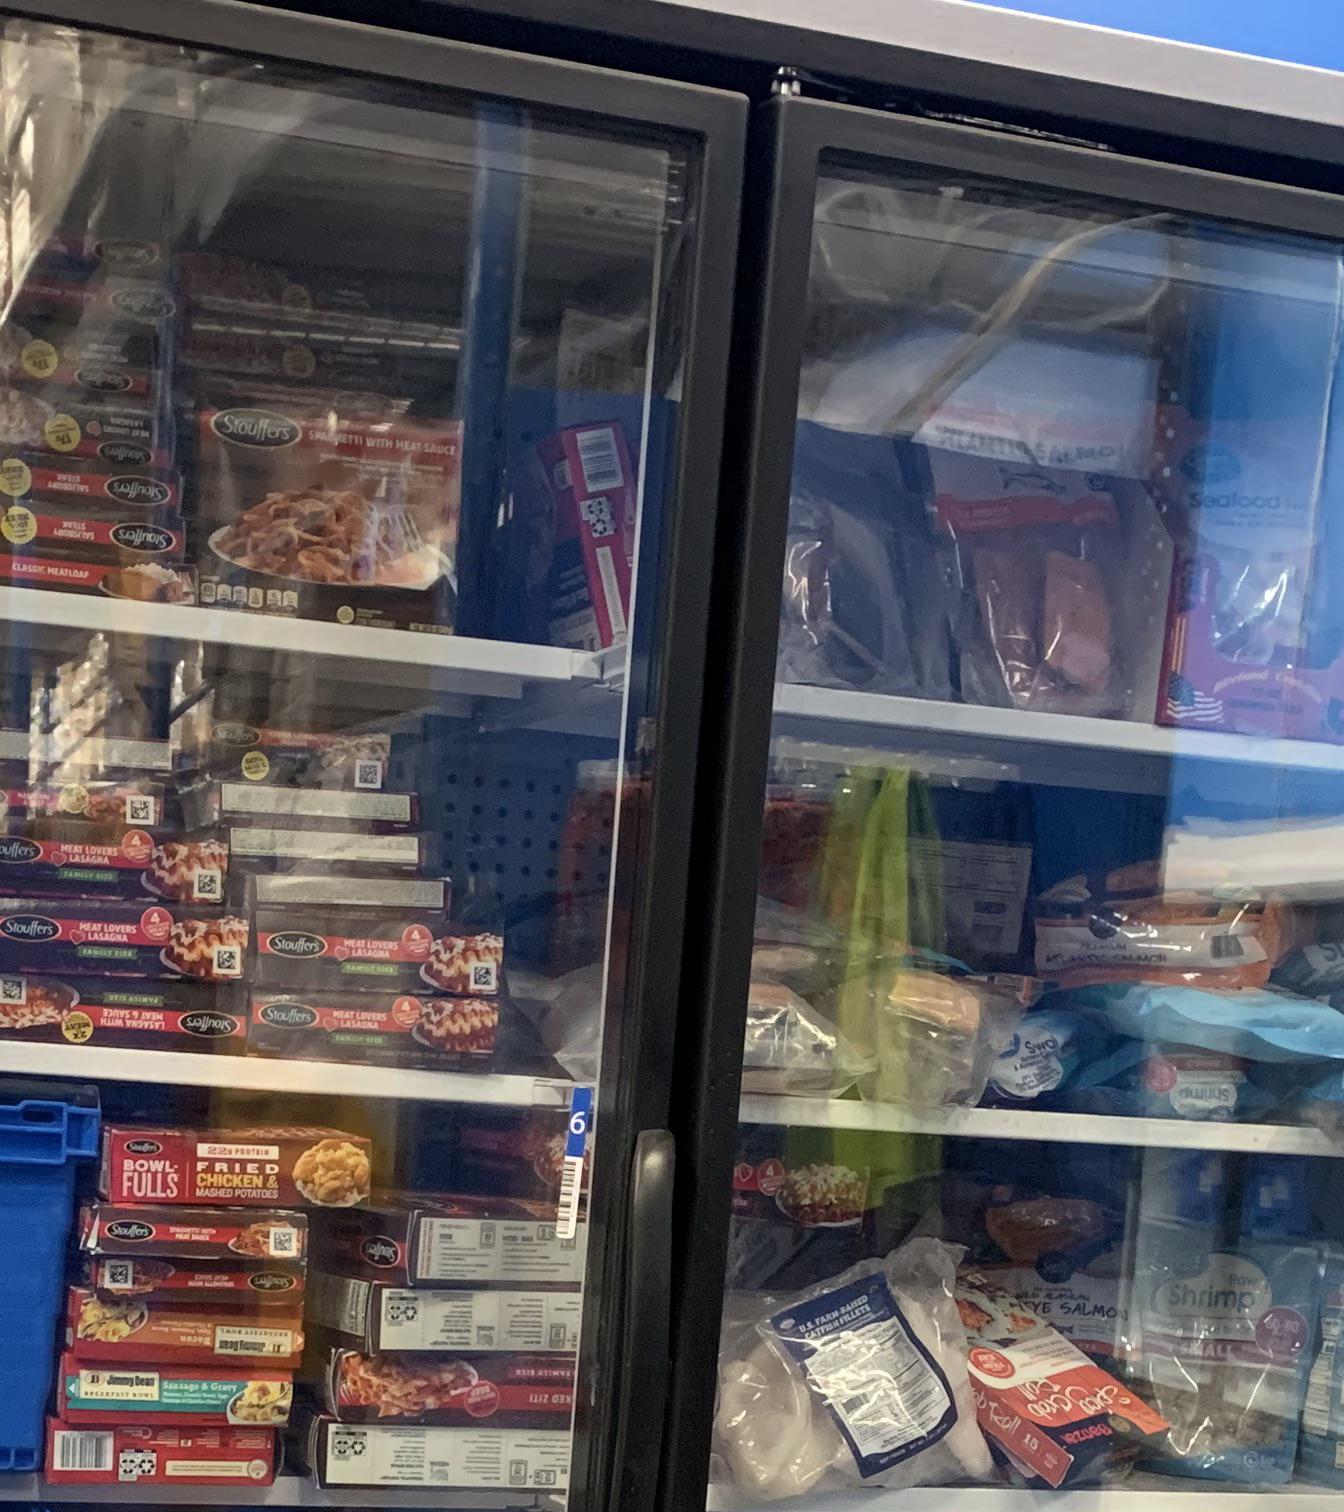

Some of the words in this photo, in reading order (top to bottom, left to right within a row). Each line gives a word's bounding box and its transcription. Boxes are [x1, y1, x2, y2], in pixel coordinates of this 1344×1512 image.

[12, 562, 46, 574] CLASSIC
[47, 564, 89, 578] MEATLOAF
[61, 845, 83, 854] MEAT
[85, 845, 118, 856] LOVERS
[69, 854, 110, 864] LASAGNA
[79, 922, 102, 932] MEAT
[104, 924, 136, 934] LOVERS
[88, 931, 129, 942] LASAGNA
[344, 939, 364, 948] MEAT
[366, 940, 398, 950] LOVERS
[333, 1010, 354, 1020] MEAT
[357, 1012, 387, 1022] LOVERS
[570, 1111, 585, 1134] 6
[197, 1162, 279, 1174] FRIED
[122, 1172, 179, 1197] FULLS
[196, 1173, 263, 1188] CHICKEN
[266, 1176, 278, 1188] &
[195, 1187, 233, 1197] MASHED
[234, 1188, 279, 1199] POTATOES
[1169, 1283, 1260, 1313] Shrimp
[799, 1319, 816, 1333] U.S.
[814, 1295, 869, 1324] FARM-RAISED
[838, 1304, 871, 1329] FILLETS
[106, 1375, 134, 1387] Jimmy
[135, 1376, 155, 1387] Dean
